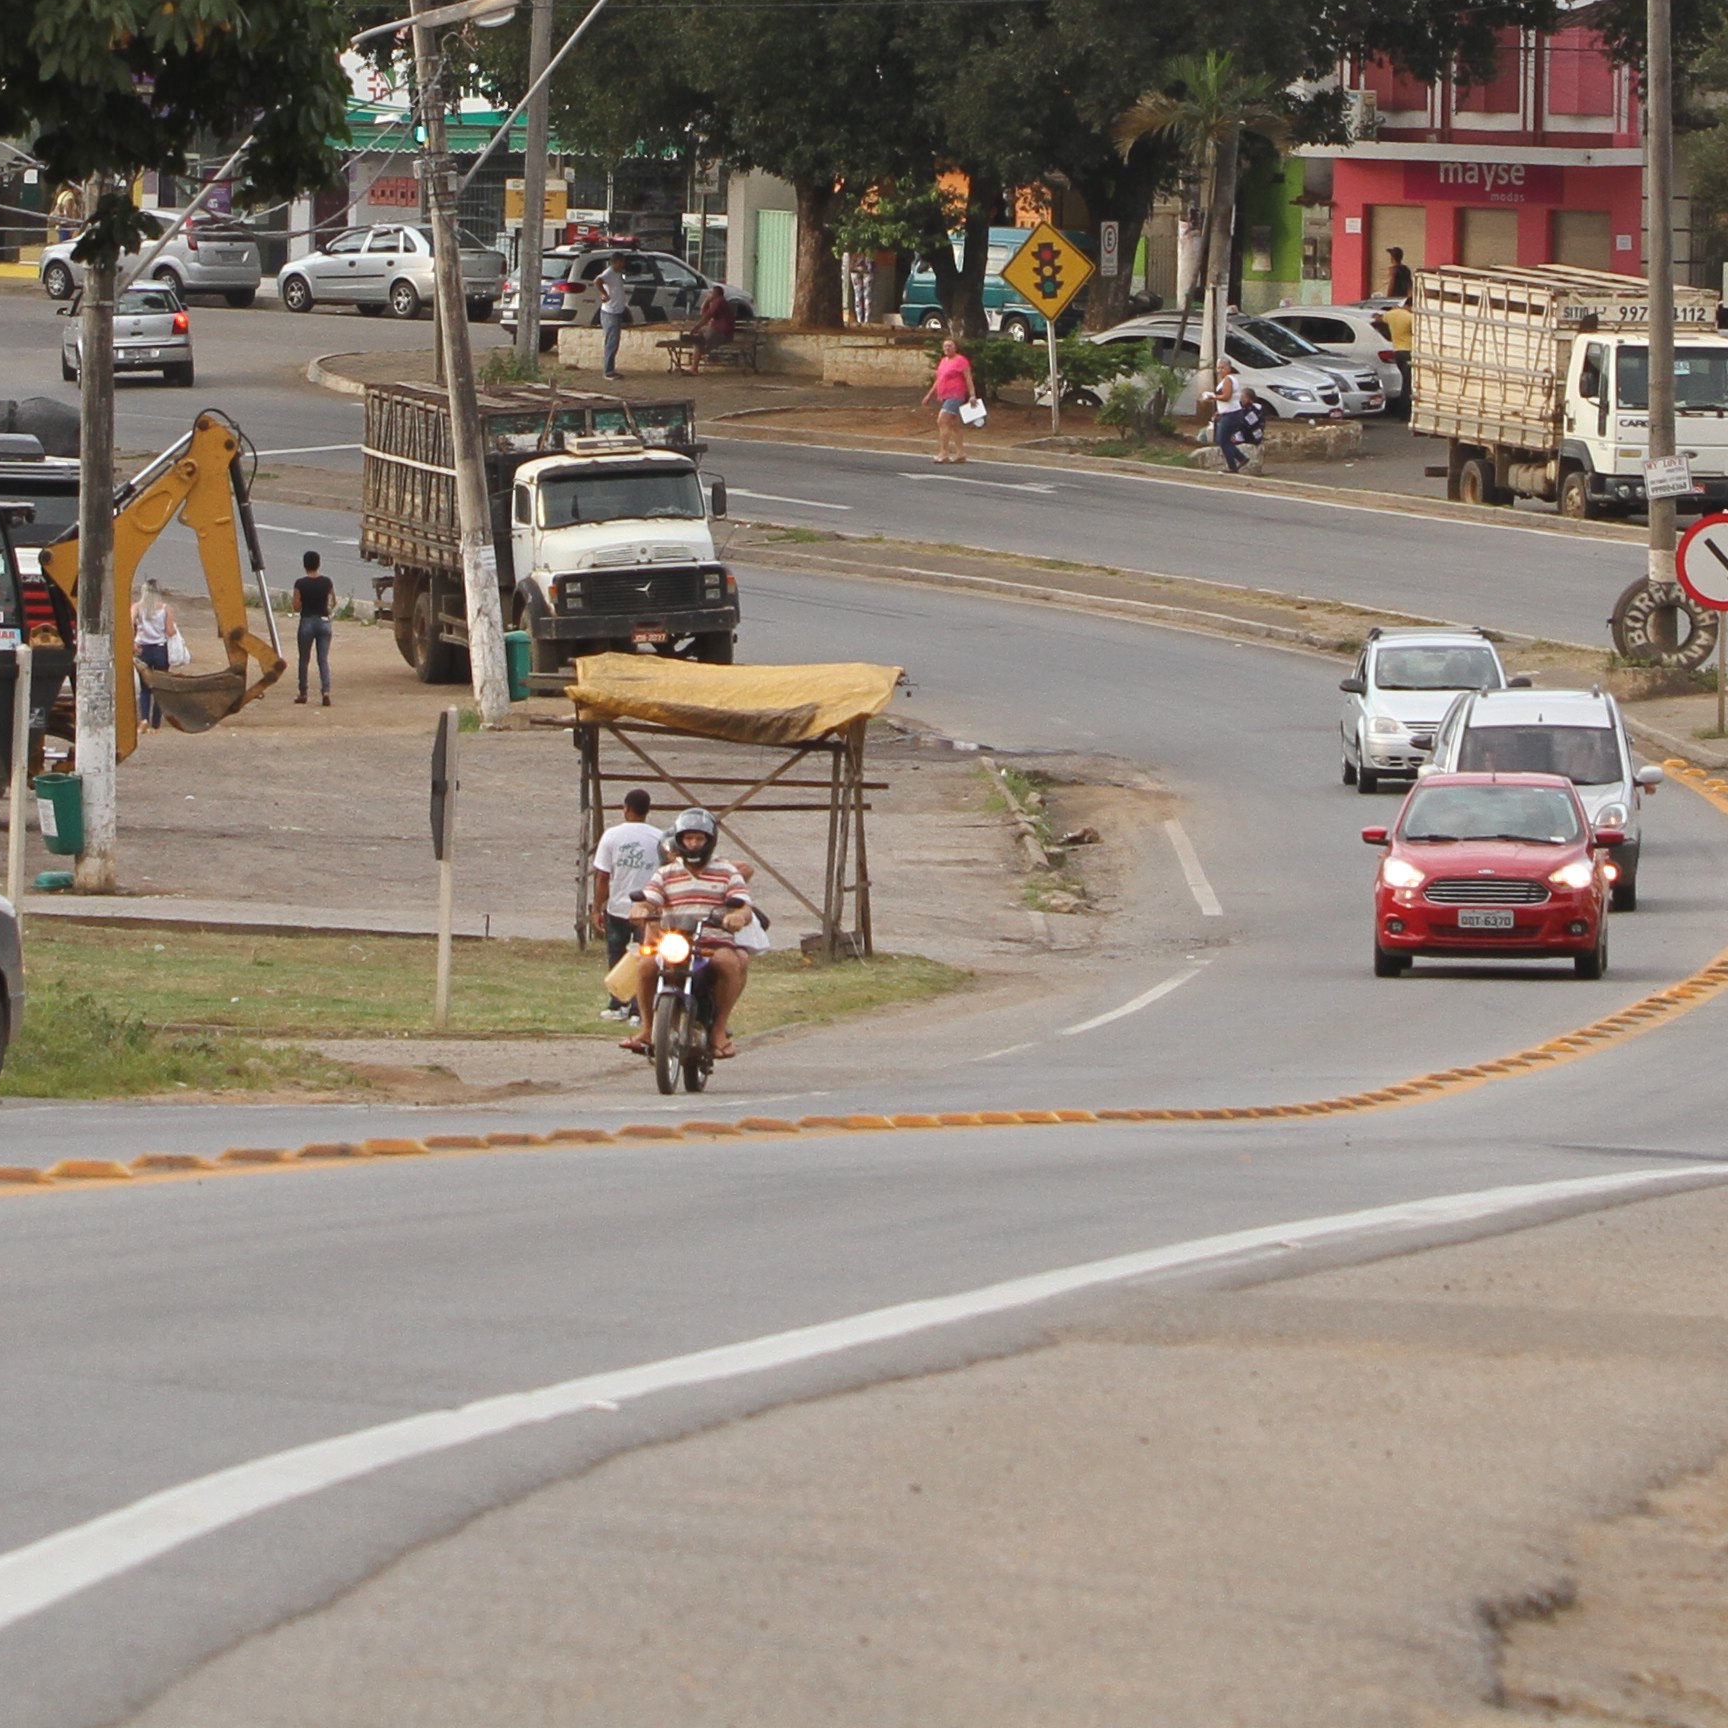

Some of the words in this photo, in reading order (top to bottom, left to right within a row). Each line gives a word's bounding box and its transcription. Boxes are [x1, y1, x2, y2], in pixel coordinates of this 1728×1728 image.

[1439, 162, 1526, 191] mayse
[1490, 192, 1525, 202] modas
[1619, 418, 1649, 428] CAR
